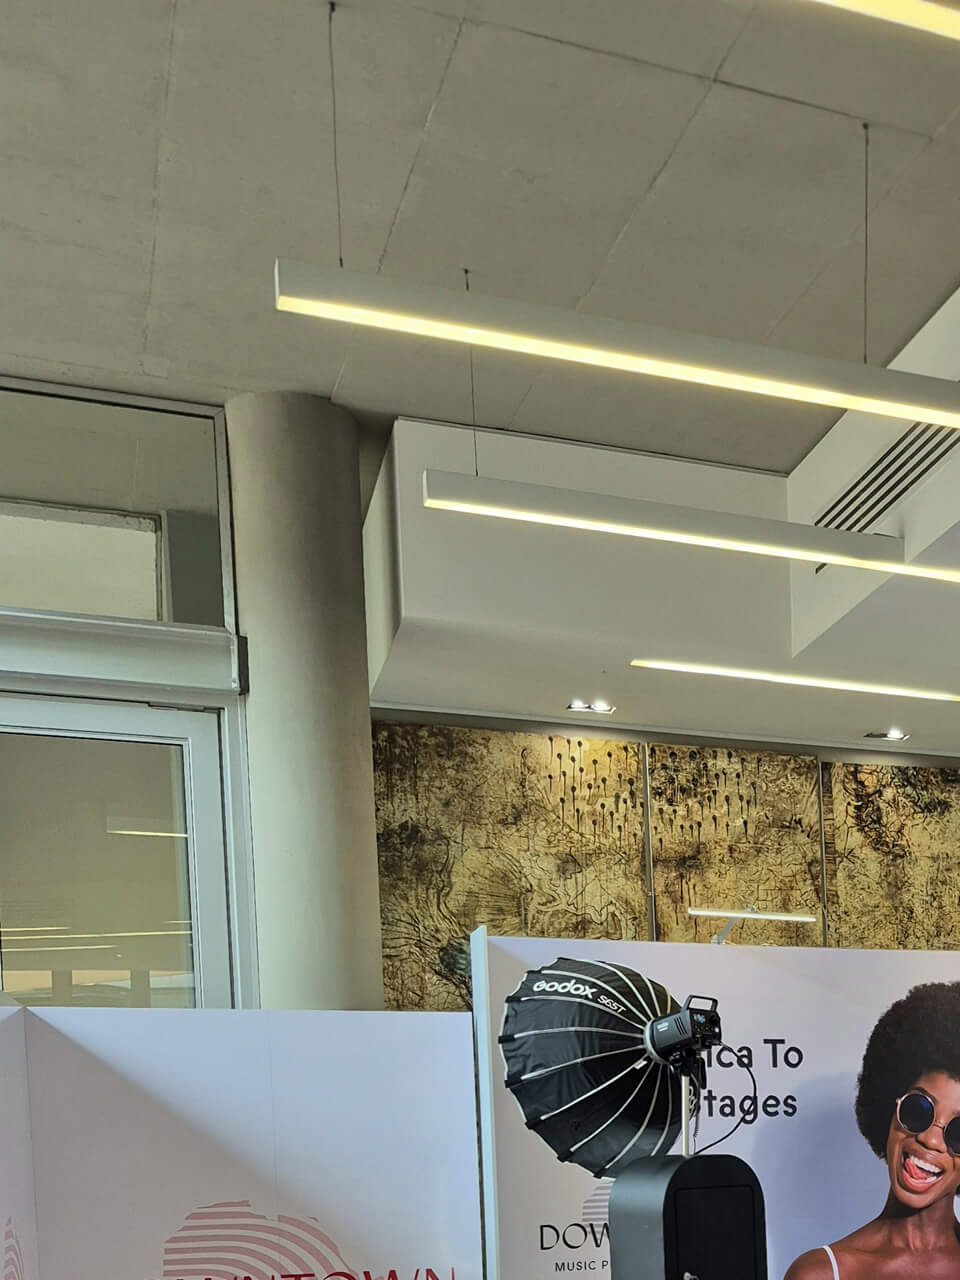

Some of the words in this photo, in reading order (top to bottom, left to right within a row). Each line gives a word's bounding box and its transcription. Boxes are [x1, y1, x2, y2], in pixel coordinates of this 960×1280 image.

[532, 980, 598, 999] Godox
[597, 994, 627, 1014] S65T
[706, 1043, 753, 1069] ica
[763, 1038, 804, 1069] To
[704, 1088, 798, 1125] tages
[554, 1260, 597, 1273] MUSIC
